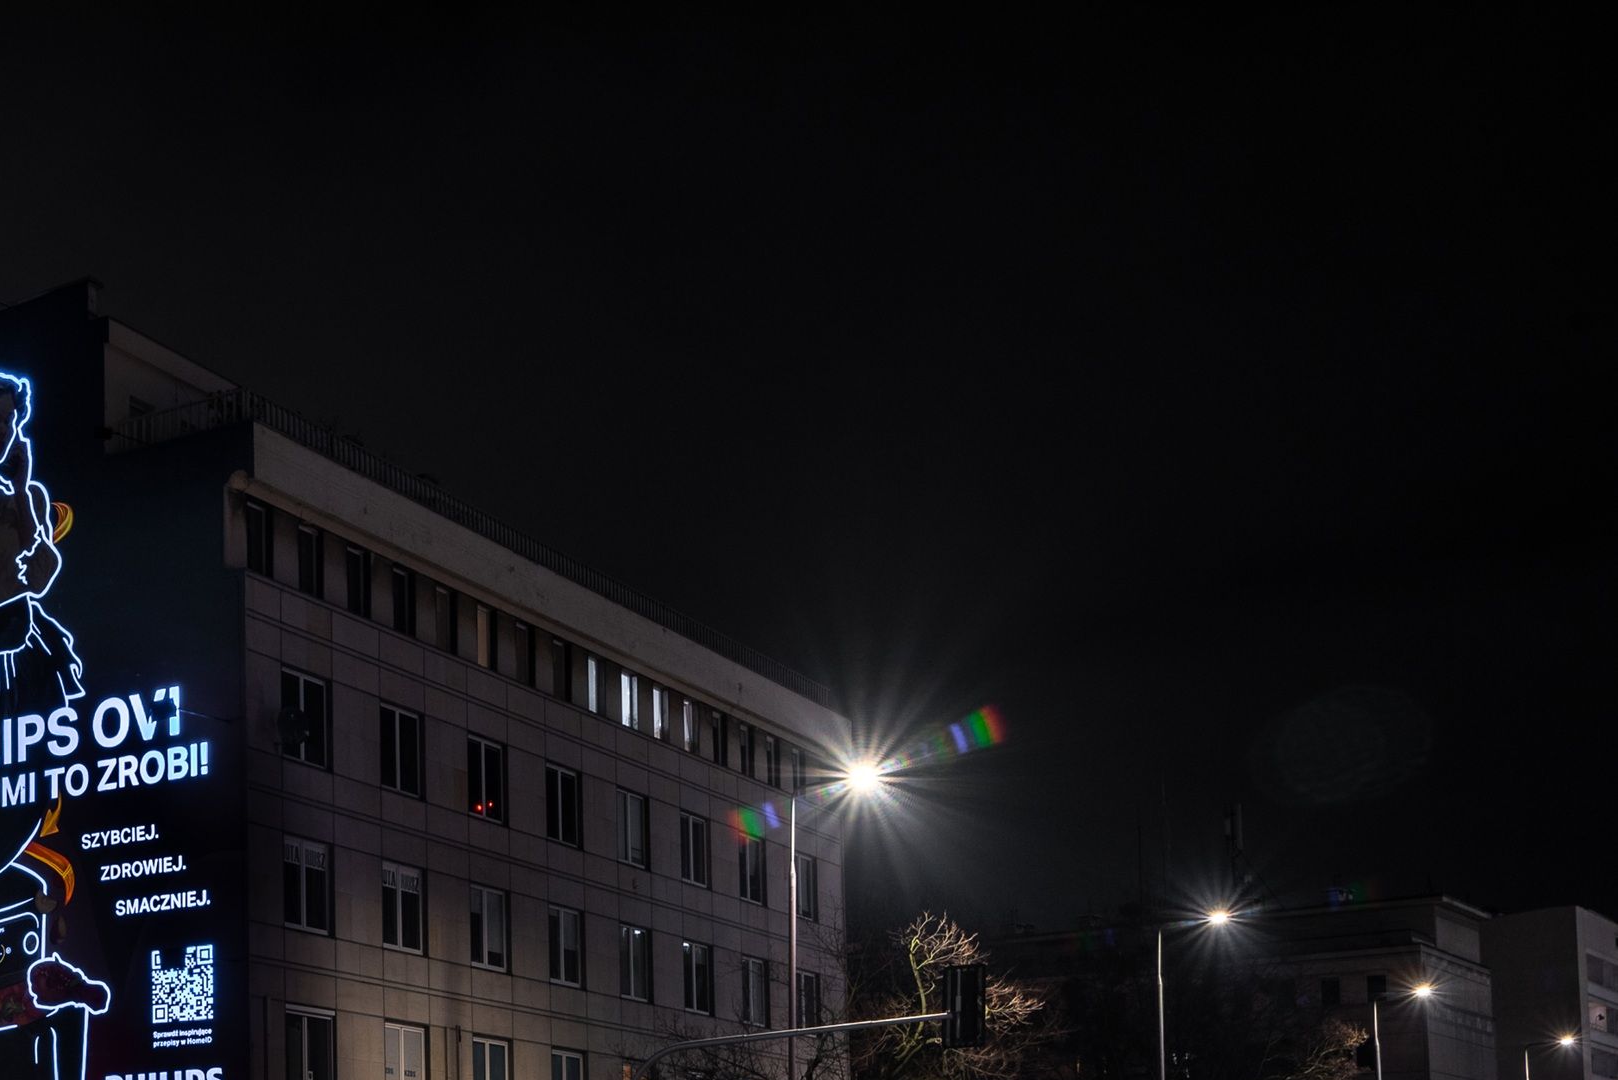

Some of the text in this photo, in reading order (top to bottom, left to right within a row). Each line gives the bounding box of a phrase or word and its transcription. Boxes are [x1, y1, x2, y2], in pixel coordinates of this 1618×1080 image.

[0, 741, 210, 808] MI TO ZROBI!
[81, 823, 160, 850] SZYBCIEJ.
[100, 854, 187, 882] ZDROWIEJ.
[115, 889, 211, 917] SMACZNIEJ.
